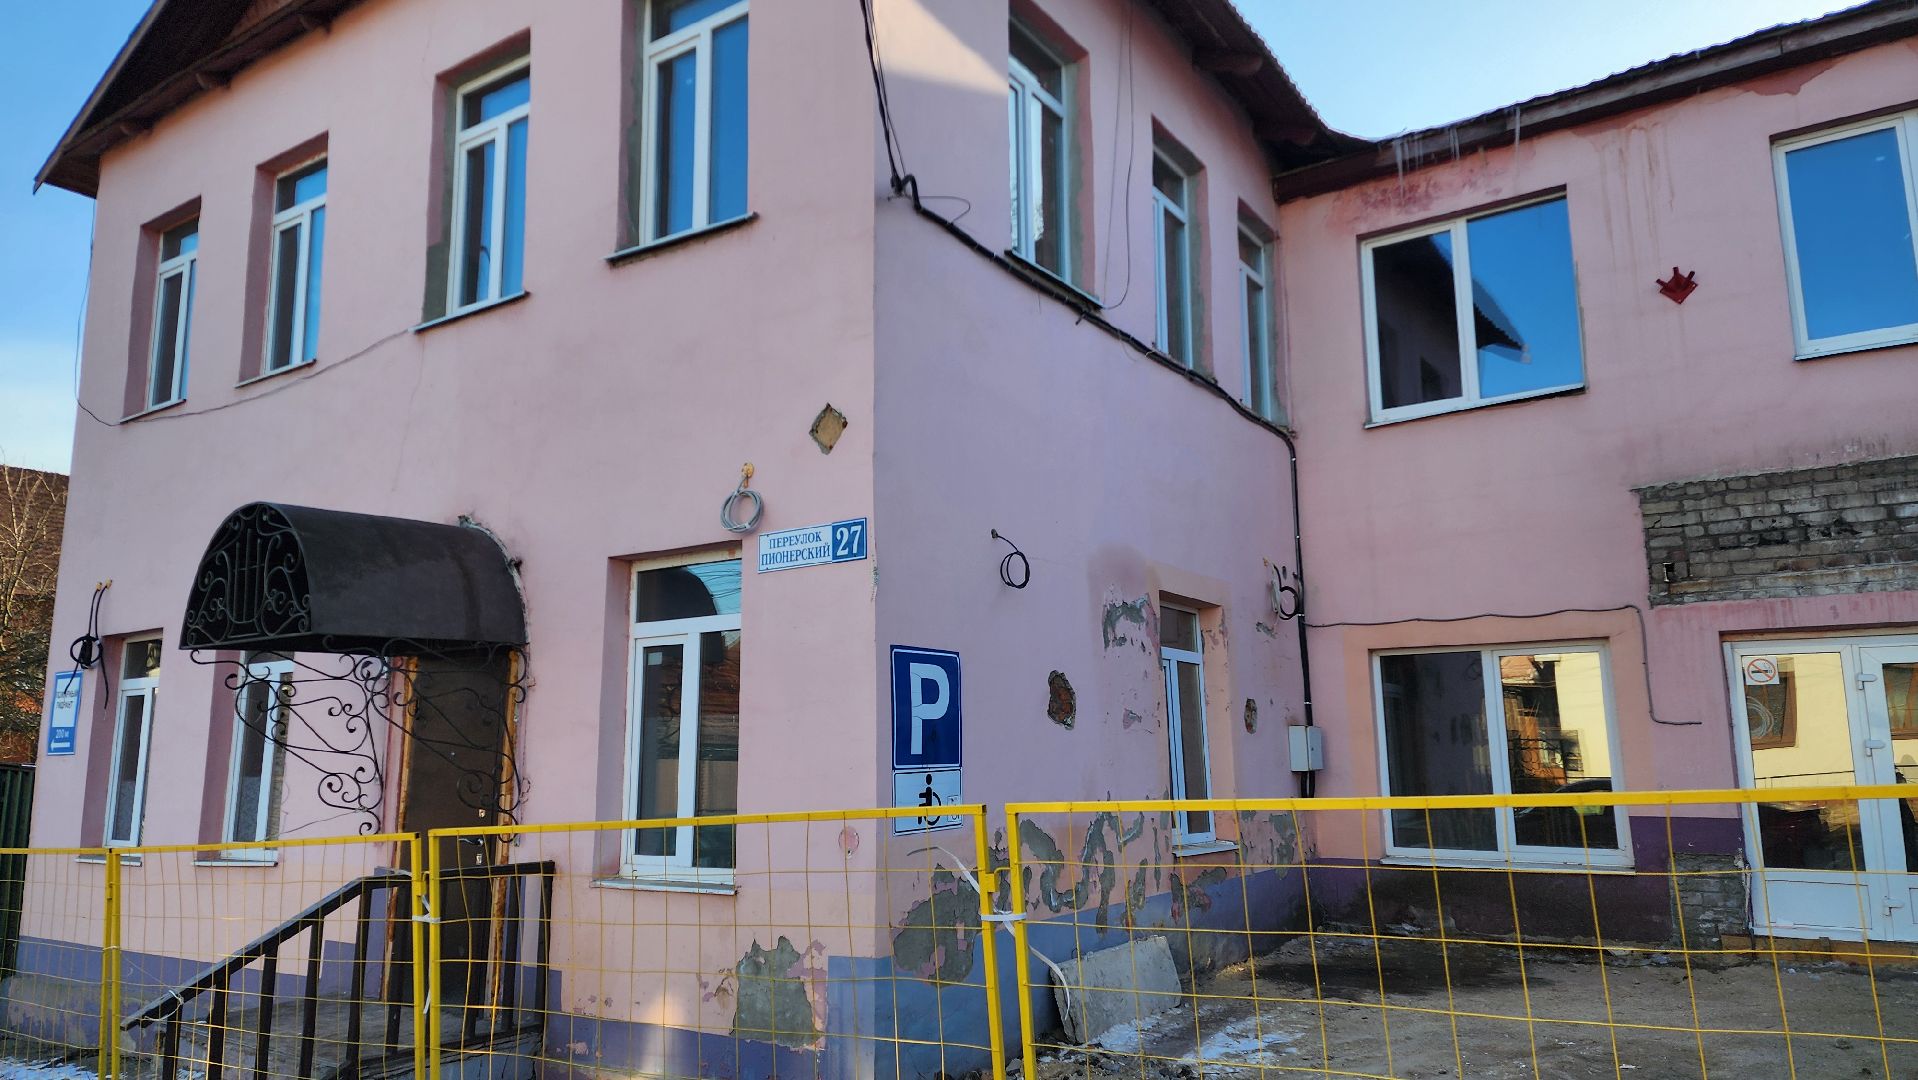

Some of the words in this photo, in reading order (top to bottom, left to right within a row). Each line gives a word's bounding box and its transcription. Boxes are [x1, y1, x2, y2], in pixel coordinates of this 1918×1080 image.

[761, 542, 831, 566] ПИОНЕРСКИЙ
[769, 531, 823, 550] ПЕРЕУЛОК
[836, 524, 862, 557] 27
[909, 662, 950, 755] P
